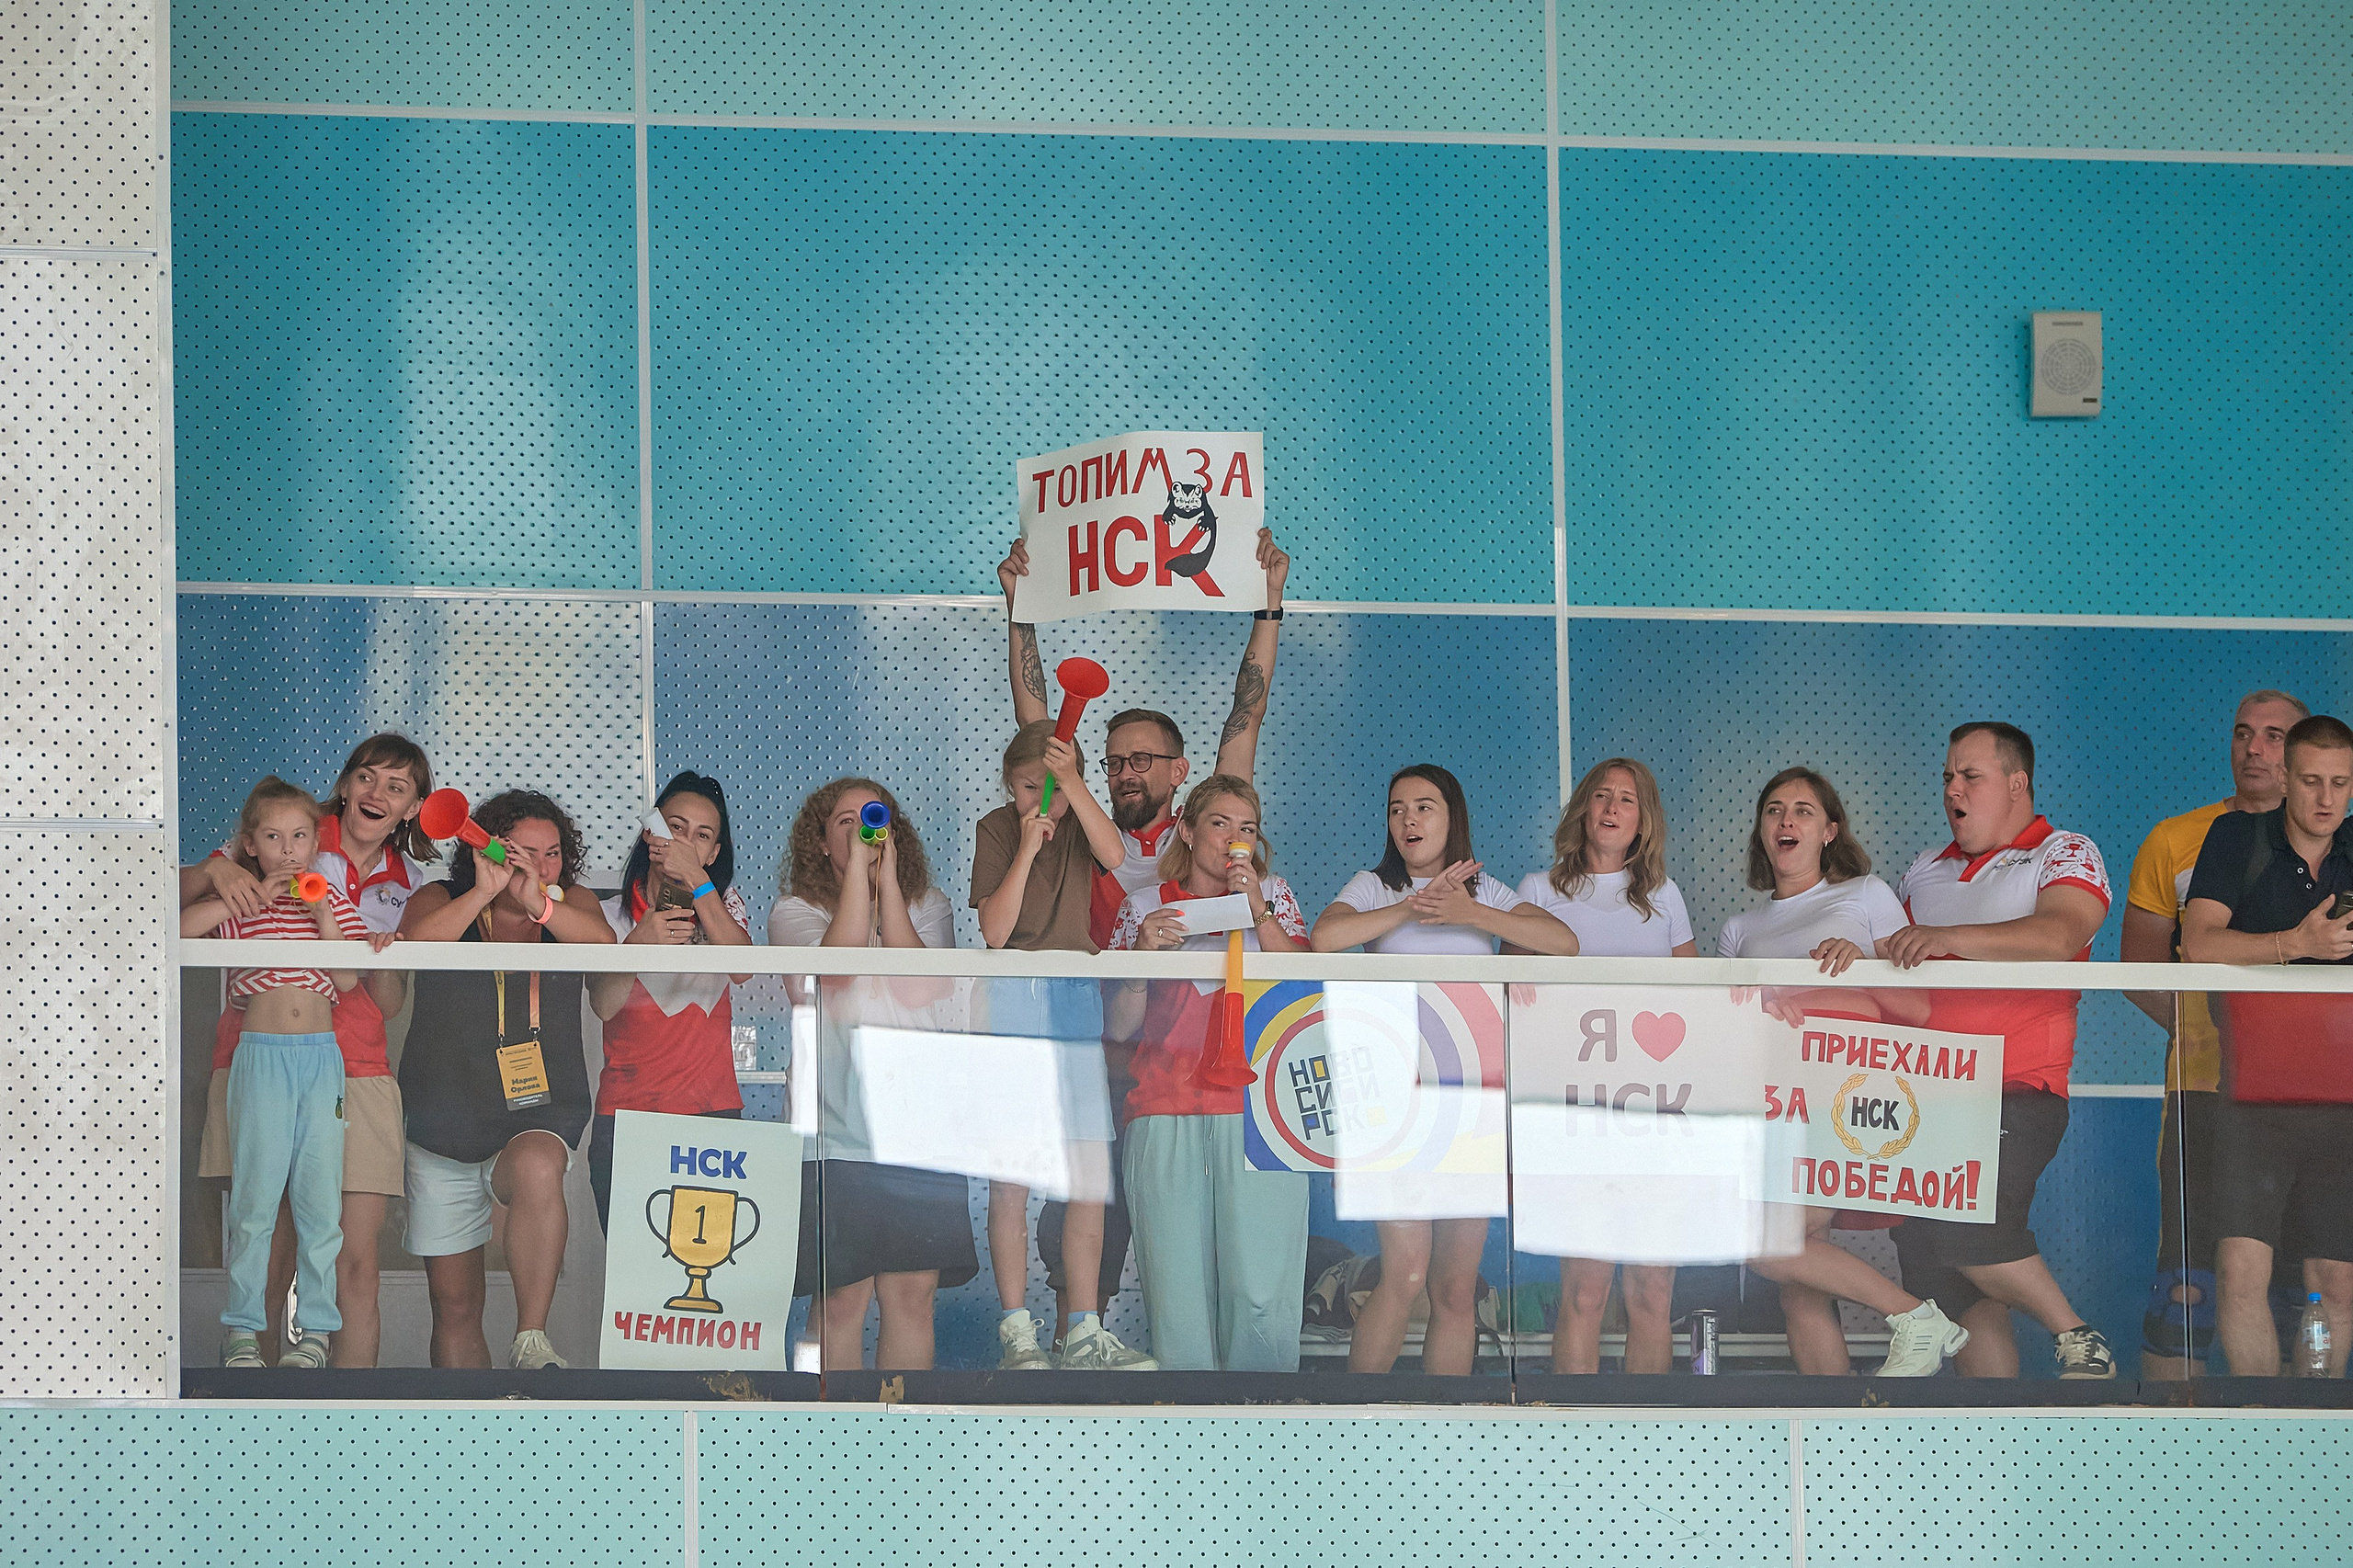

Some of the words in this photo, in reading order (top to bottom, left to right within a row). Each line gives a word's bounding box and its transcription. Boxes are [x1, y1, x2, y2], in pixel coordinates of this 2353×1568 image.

[1032, 448, 1174, 513] ТОПИМ
[1186, 448, 1253, 498] ЗА
[1068, 514, 1226, 597] НСК
[1577, 1009, 1618, 1062] Я
[1802, 1030, 1978, 1081] ПРИЕХАЛИ
[1288, 1045, 1375, 1087] НОВО
[1565, 1083, 1695, 1138] НСК
[1764, 1085, 1810, 1124] ЗА
[1850, 1096, 1900, 1131] НСК
[670, 1145, 747, 1179] НСК
[1791, 1156, 1982, 1210] ПОБЕДОЙ!
[691, 1205, 707, 1244] 1
[614, 1311, 762, 1350] ЧЕМПИОН
